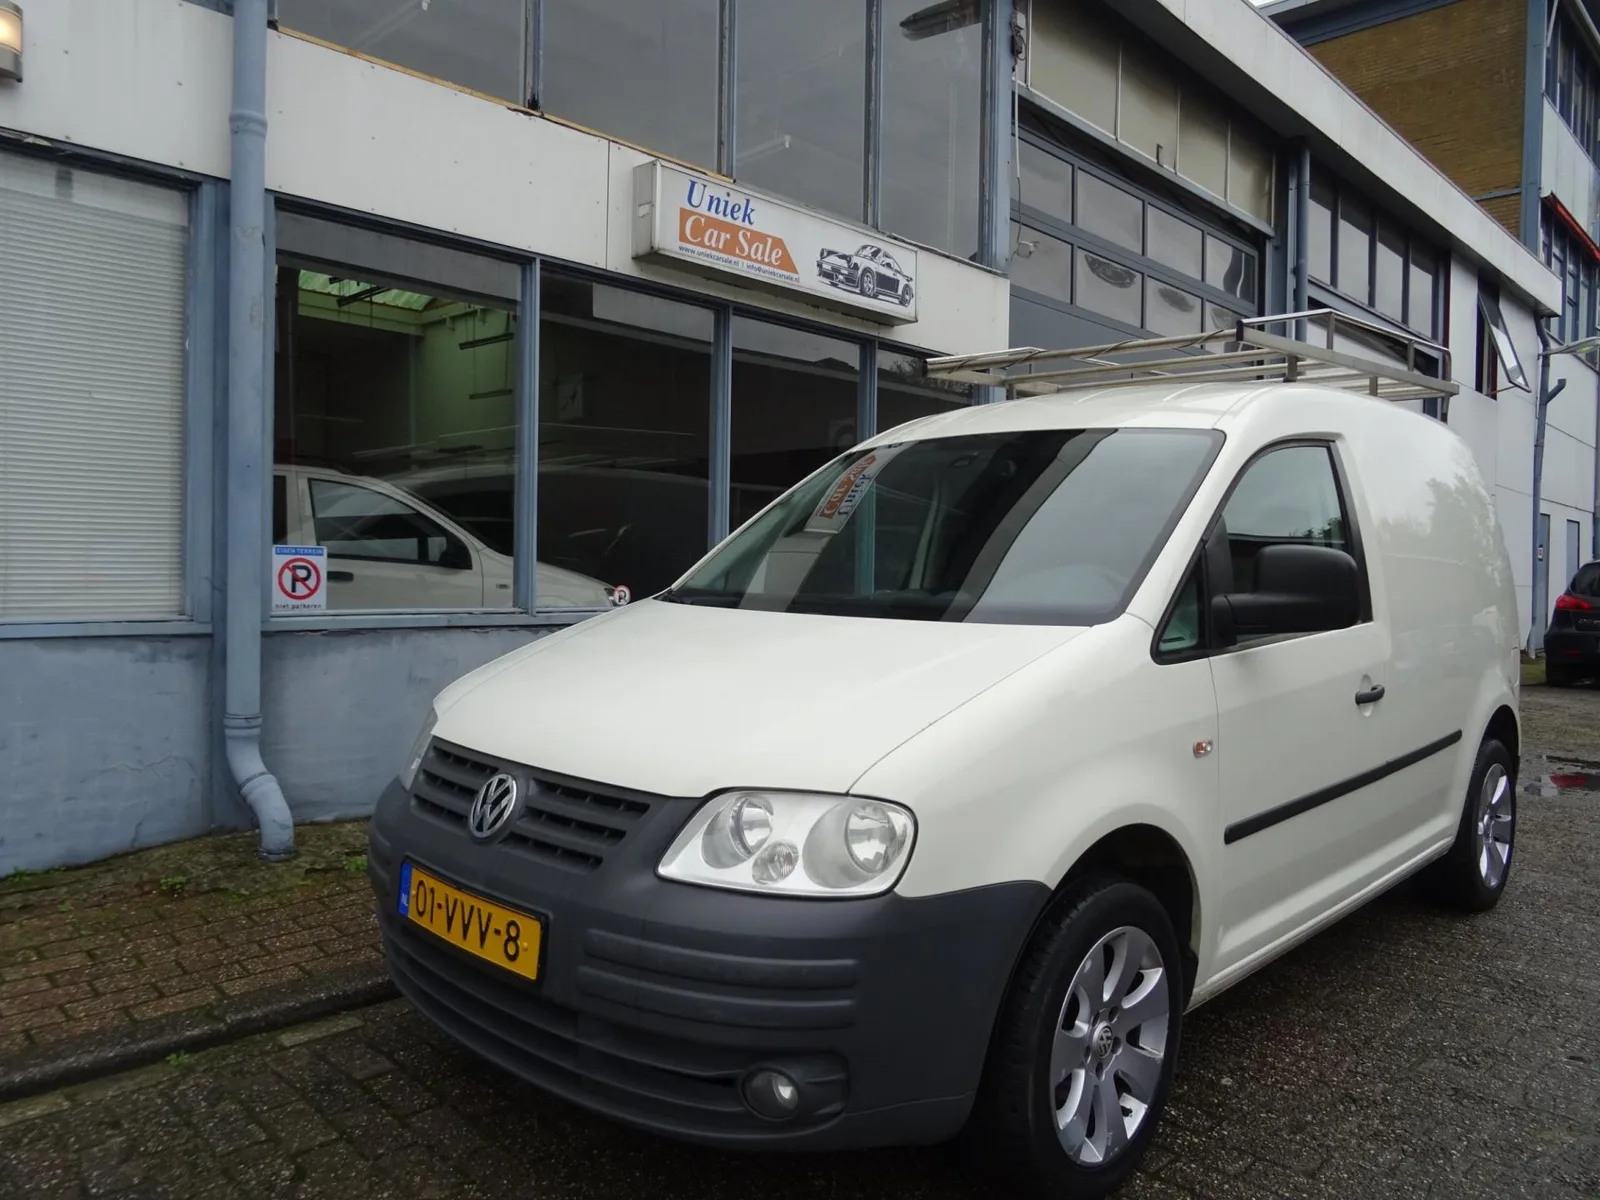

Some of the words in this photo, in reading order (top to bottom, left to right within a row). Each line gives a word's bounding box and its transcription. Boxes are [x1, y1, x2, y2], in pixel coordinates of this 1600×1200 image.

[687, 179, 756, 225] Uniek
[685, 215, 731, 250] Car
[735, 229, 783, 266] Sale
[678, 245, 740, 267] www.uniekcarsale.nl
[745, 263, 800, 283] info@uniekcarsale.nl
[291, 564, 312, 593] P
[415, 879, 521, 963] 01-VVV-8
